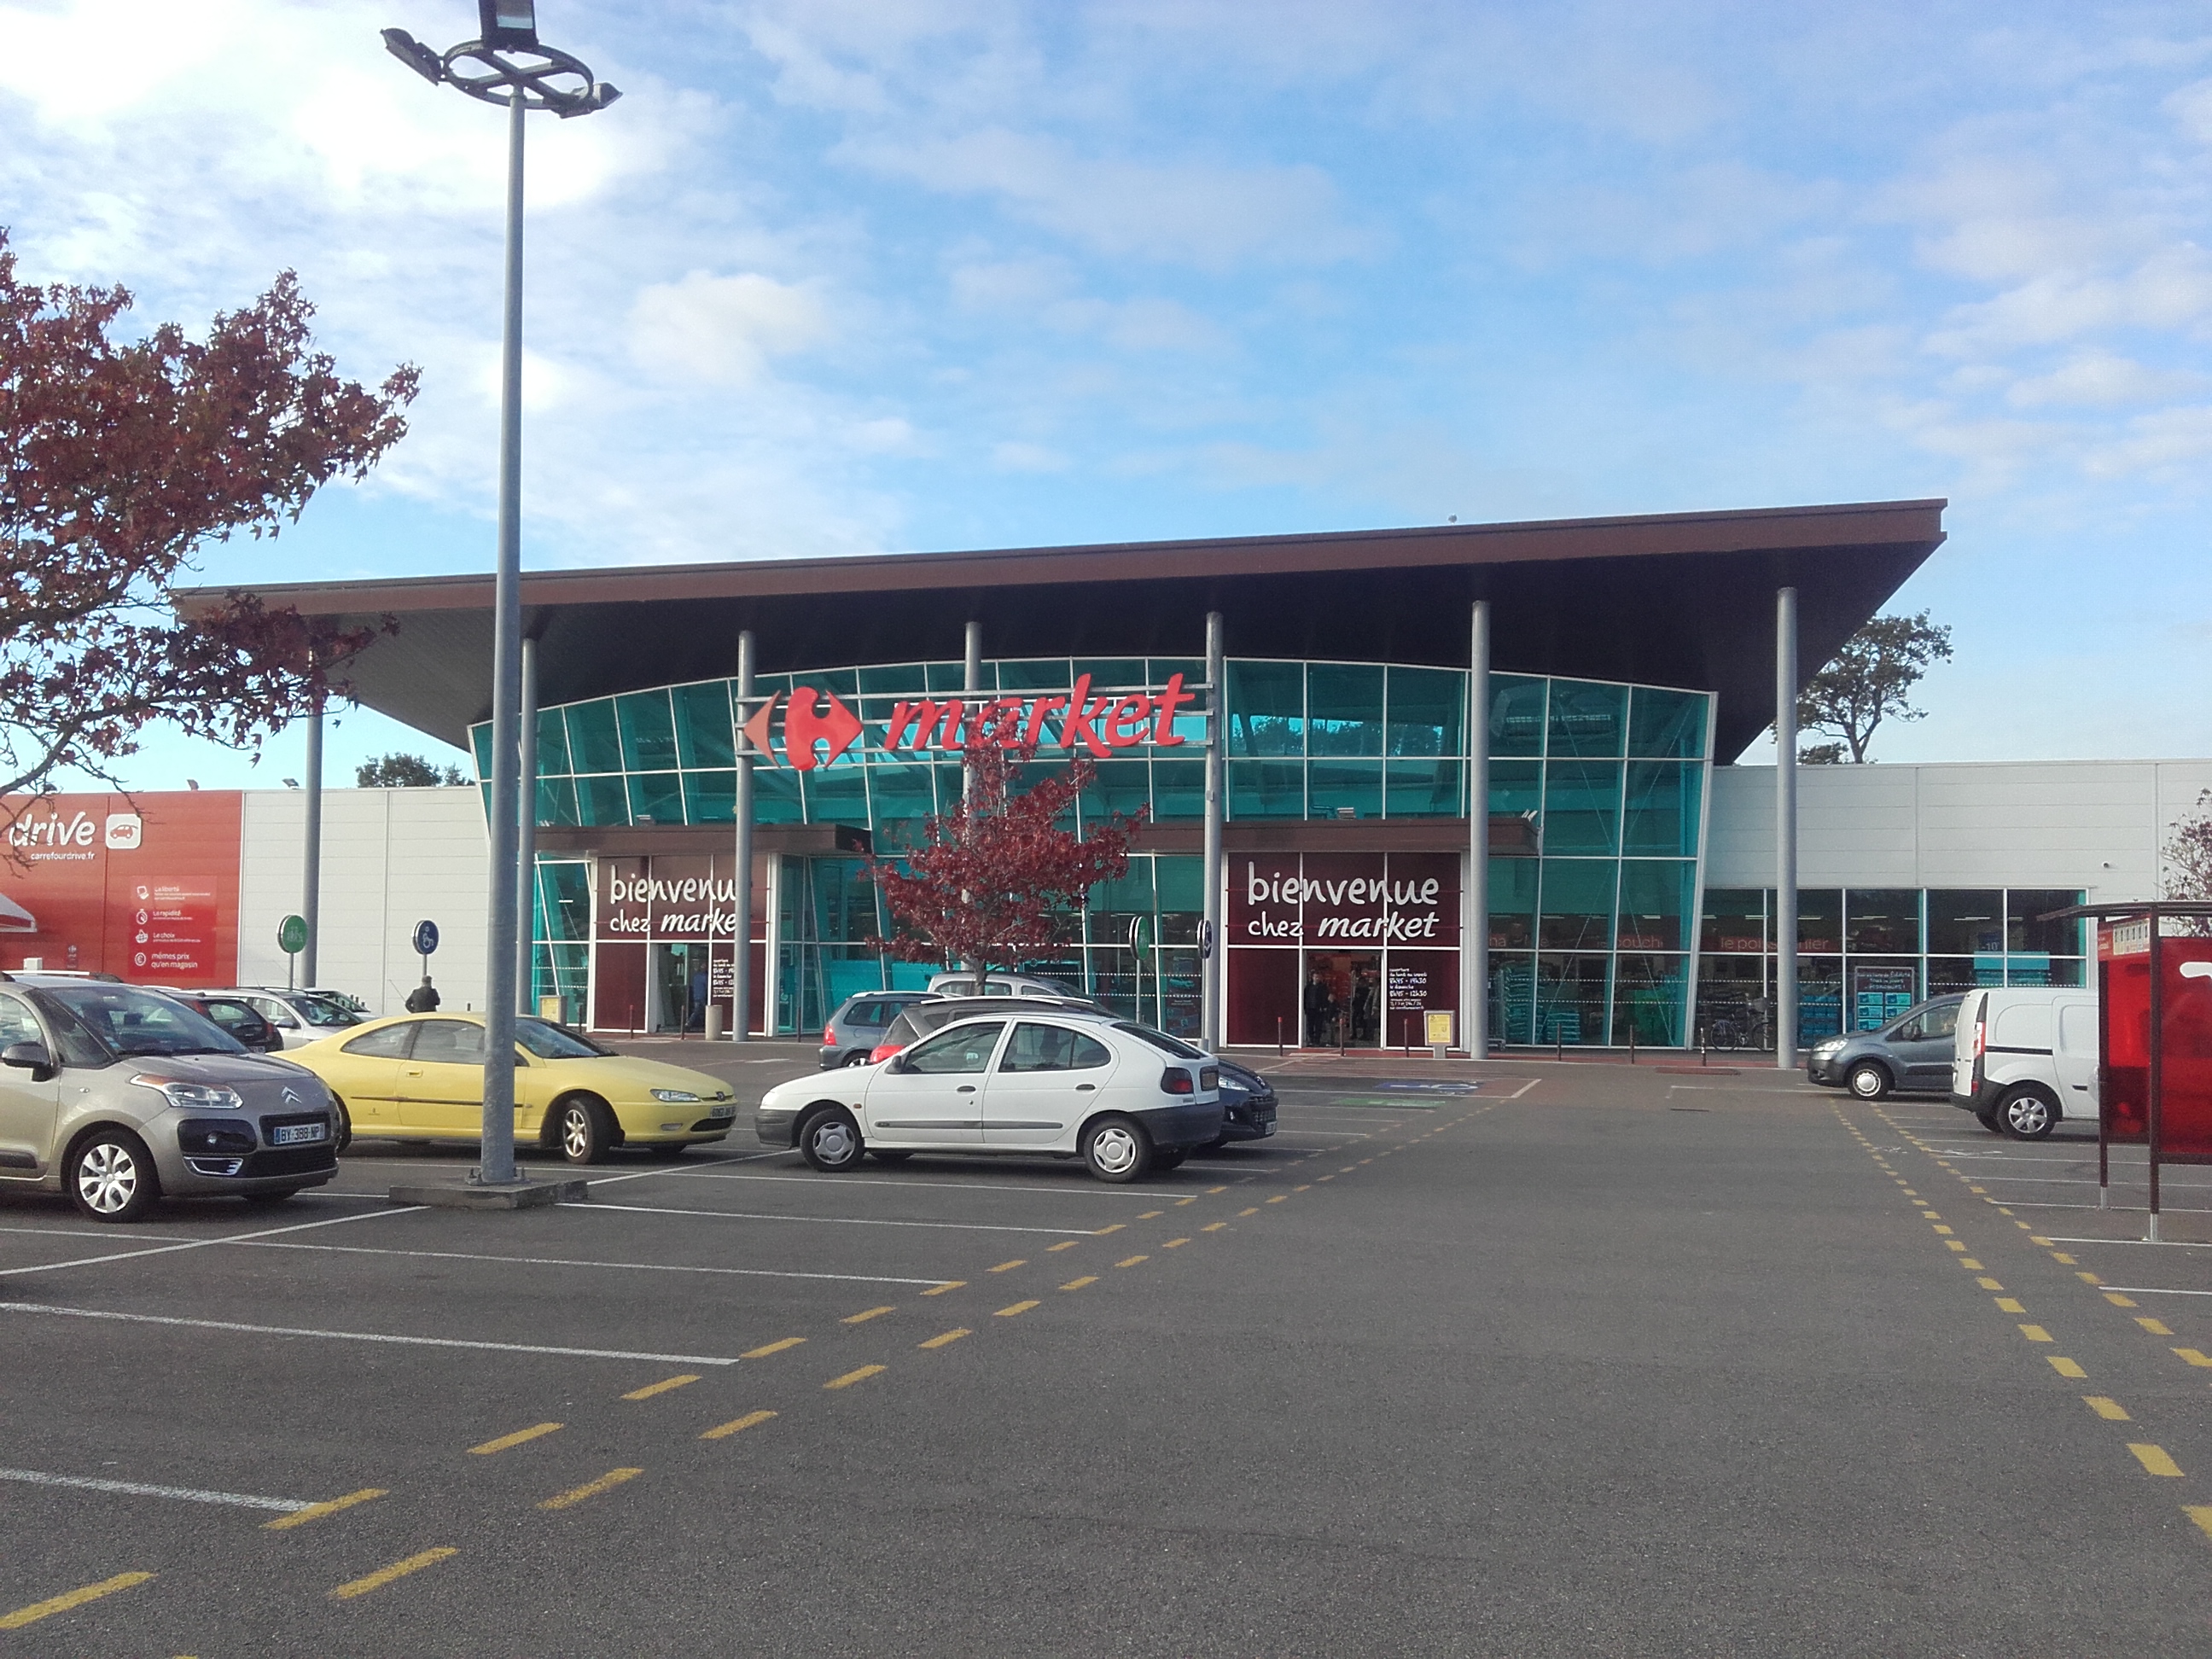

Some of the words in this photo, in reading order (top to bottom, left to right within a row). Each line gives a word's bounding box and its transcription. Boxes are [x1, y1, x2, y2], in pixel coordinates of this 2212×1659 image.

[883, 673, 1195, 758] market
[9, 812, 96, 846] drive
[31, 852, 96, 860] carrefourdrive.fr
[609, 864, 736, 904] bienvenu
[1248, 861, 1439, 905] bienvenue
[610, 909, 651, 932] chez
[661, 907, 736, 934] marke
[1249, 911, 1303, 936] chez
[1318, 911, 1440, 940] market
